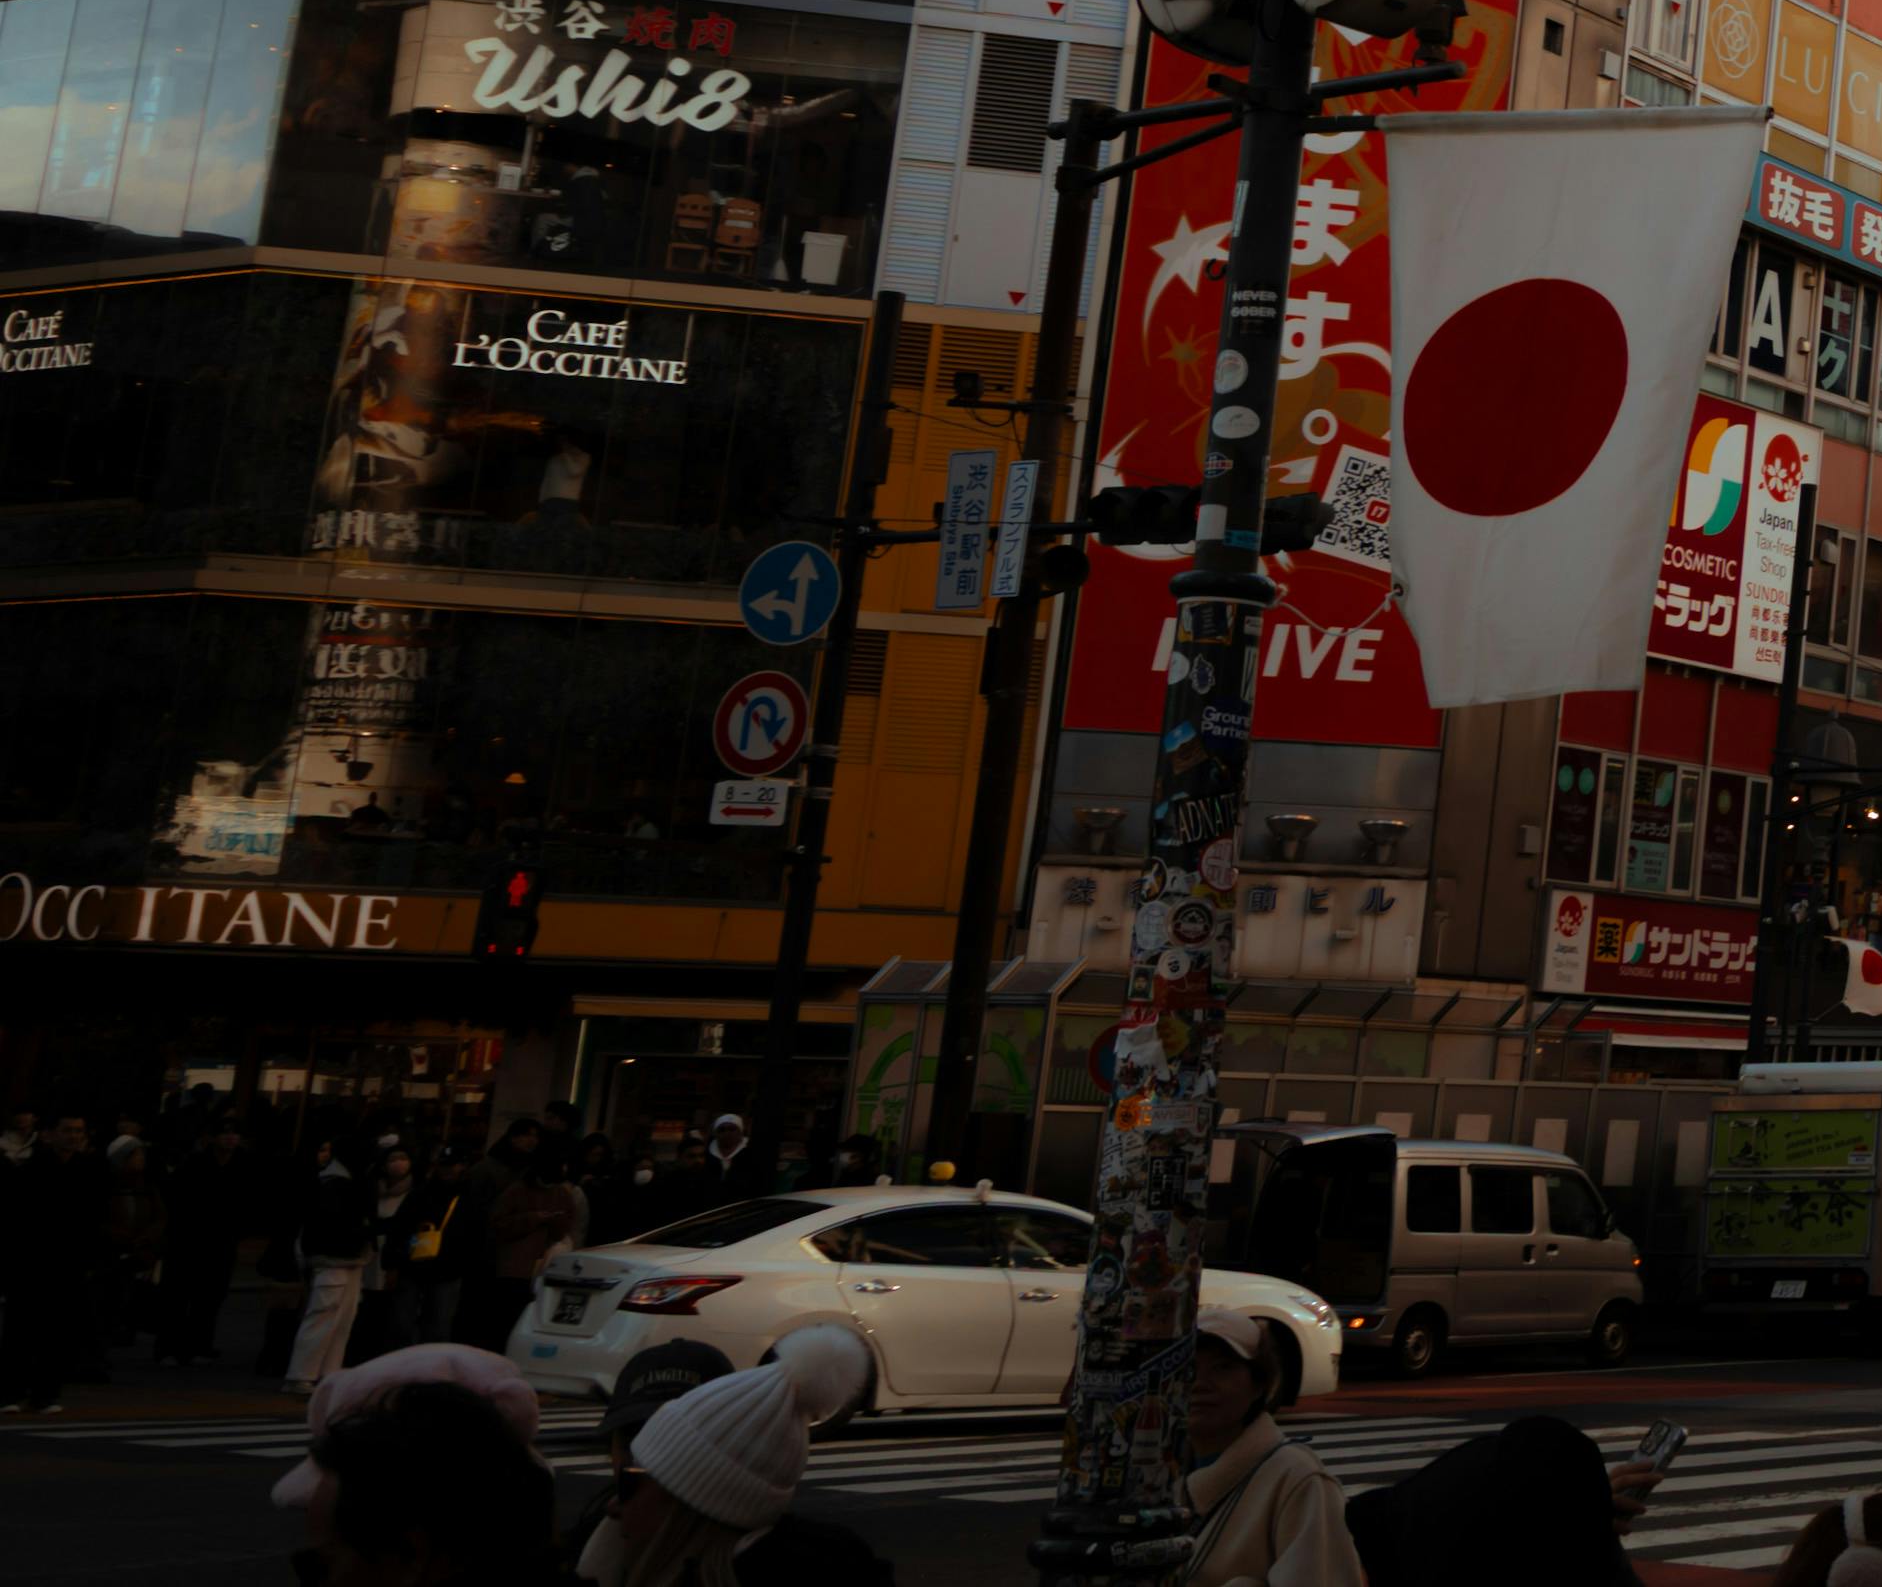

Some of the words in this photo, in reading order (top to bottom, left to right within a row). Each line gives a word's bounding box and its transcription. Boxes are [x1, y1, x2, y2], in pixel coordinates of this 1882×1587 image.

[1768, 168, 1835, 243] 抜毛
[0, 341, 93, 374] CCITANE
[946, 485, 964, 545] Shibuya
[956, 463, 989, 596] 渋谷駅前
[1661, 542, 1738, 582] COSMETIC
